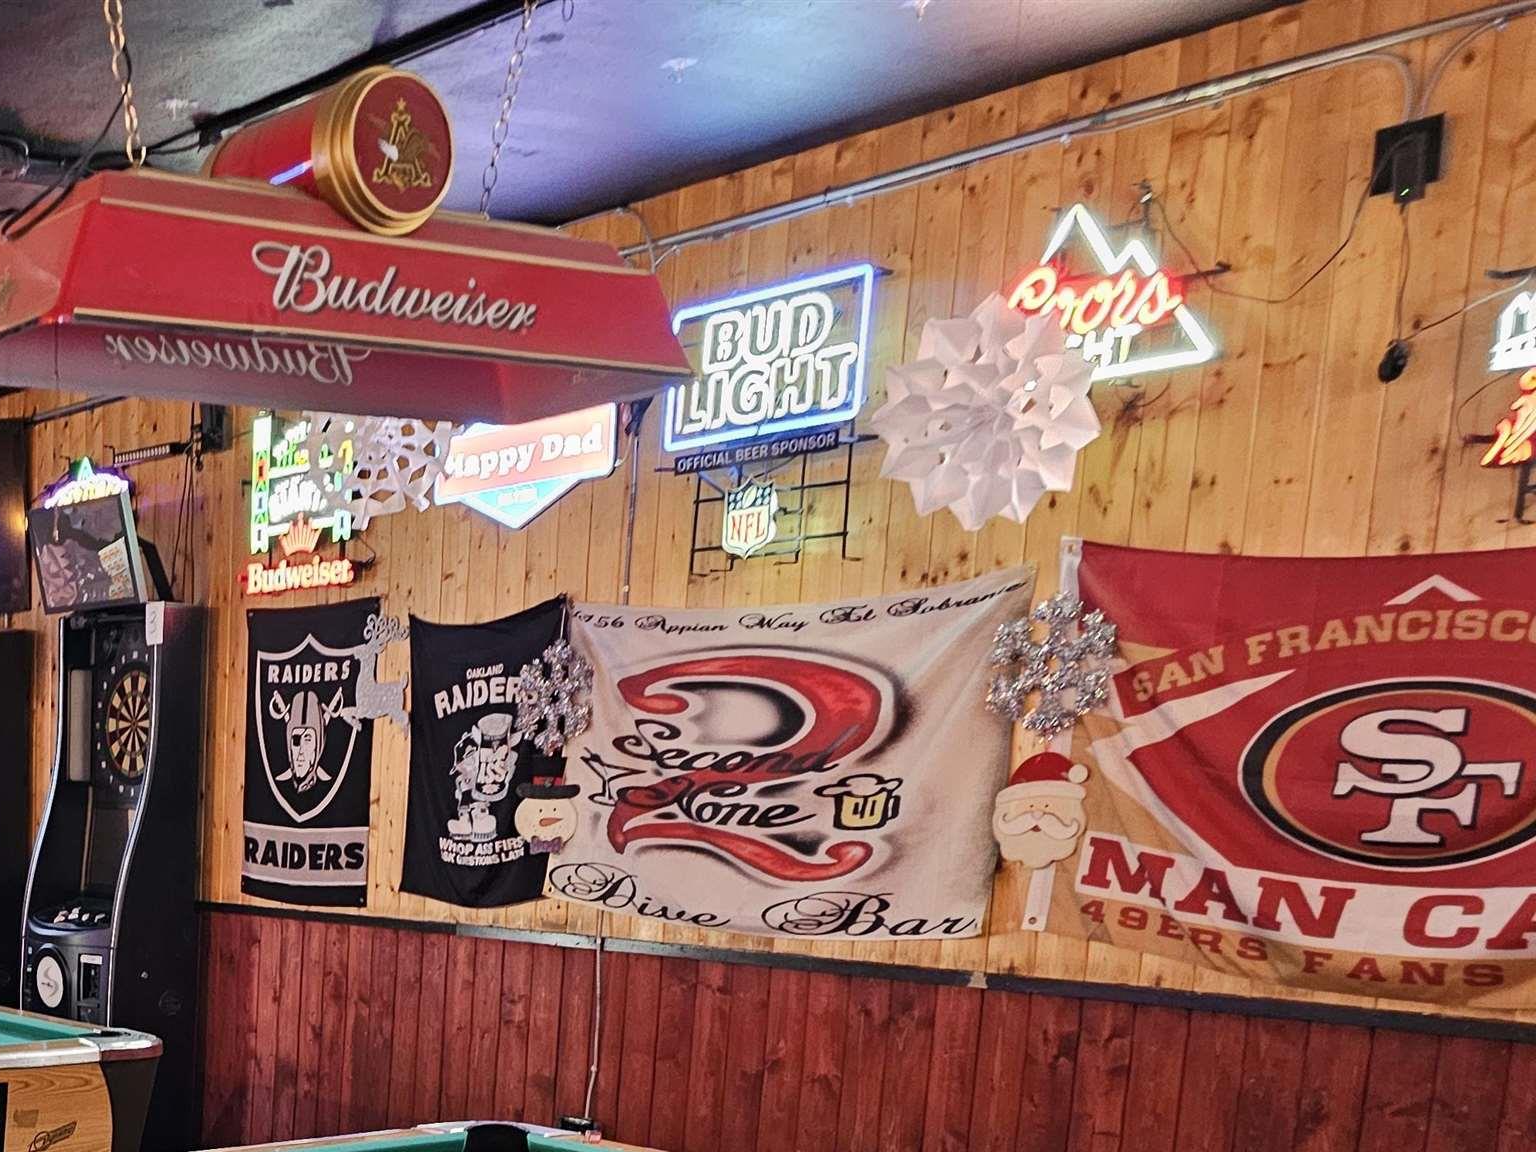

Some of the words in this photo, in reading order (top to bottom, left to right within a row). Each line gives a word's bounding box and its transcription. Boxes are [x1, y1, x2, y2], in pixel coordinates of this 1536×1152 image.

[251, 240, 537, 331] Budweiser
[702, 291, 834, 374] BUD
[674, 342, 858, 434] LIGHT
[444, 442, 536, 480] Happy
[541, 423, 602, 462] Dad
[678, 451, 732, 473] OFFICIAL
[736, 443, 768, 463] BEER
[771, 432, 837, 457] SPONSOR
[730, 512, 765, 541] NFL
[247, 556, 354, 594] Budweiser
[635, 614, 729, 635] Appian
[738, 612, 809, 632] Way
[819, 604, 877, 625] El
[267, 660, 351, 684] RAIDERS
[434, 676, 528, 719] RAIDER
[466, 663, 504, 680] OAKLAND
[1132, 645, 1224, 702] SAN
[612, 719, 858, 774] Second
[1332, 708, 1524, 846] SF
[244, 838, 364, 871] RAIDERS
[549, 863, 730, 927] Dive
[762, 891, 976, 938] Bar
[1081, 837, 1357, 939] MAN
[1403, 895, 1536, 951] CA
[1080, 899, 1269, 962] 49ERS
[1302, 949, 1505, 988] FANS
